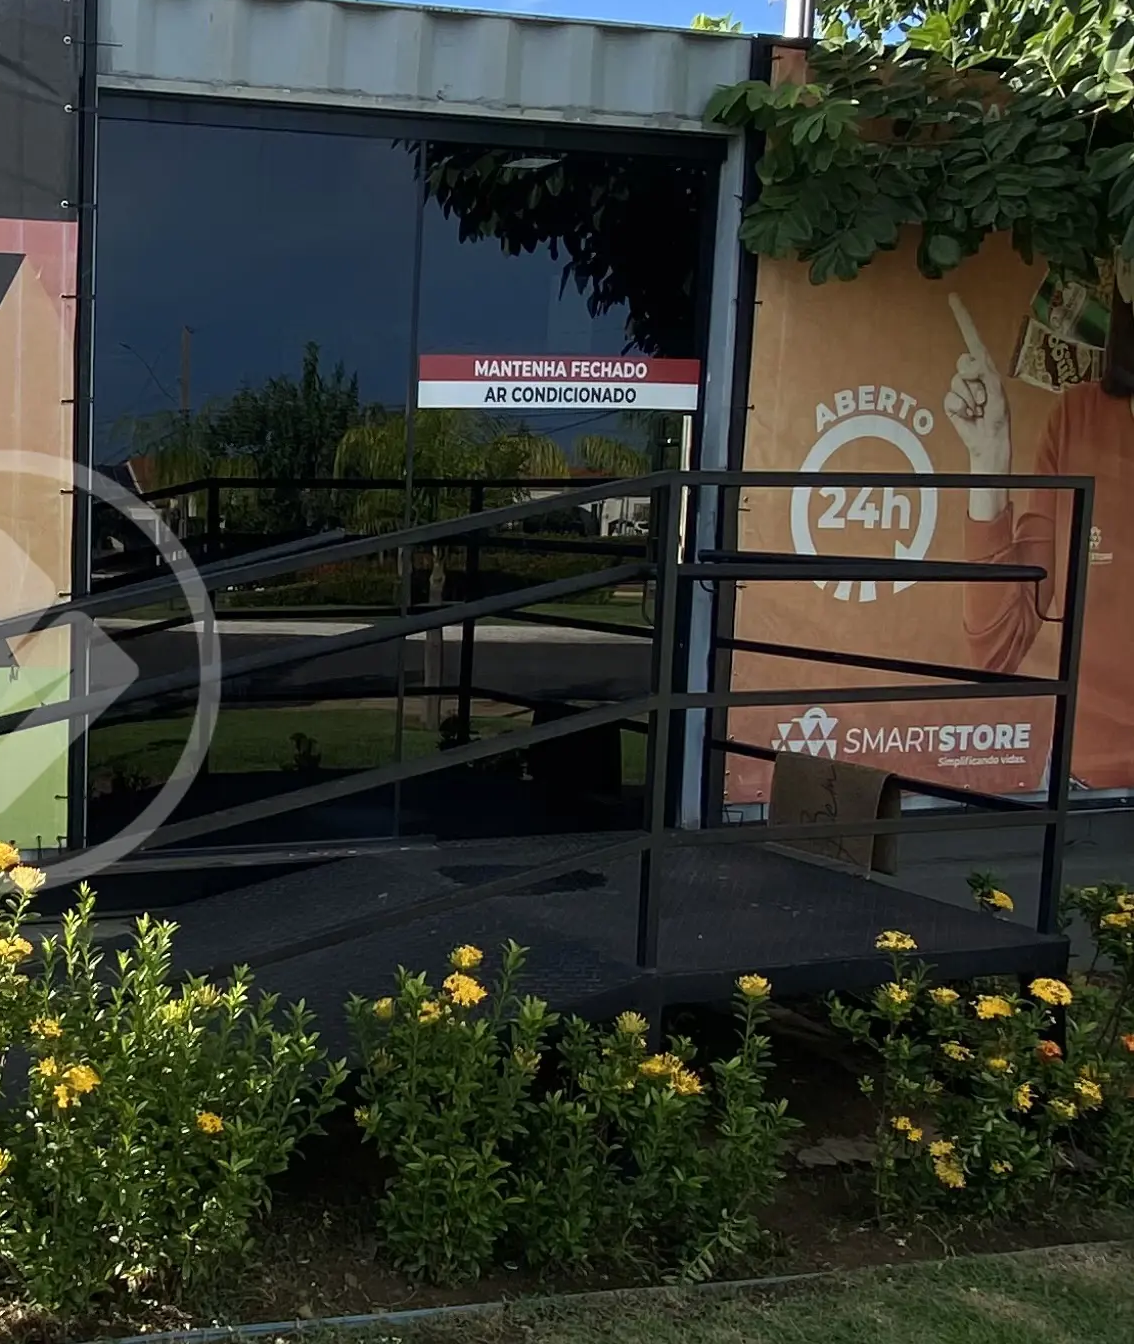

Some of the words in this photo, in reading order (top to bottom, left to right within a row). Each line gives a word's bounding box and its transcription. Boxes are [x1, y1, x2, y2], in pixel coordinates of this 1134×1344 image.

[474, 360, 567, 377] MANTENHA
[571, 361, 648, 378] FECHADO
[484, 387, 507, 403] AR
[512, 387, 637, 403] CONDICIONADO
[815, 385, 934, 435] ABERTO
[817, 486, 910, 529] 24h
[845, 723, 1031, 754] SMARTSTORE
